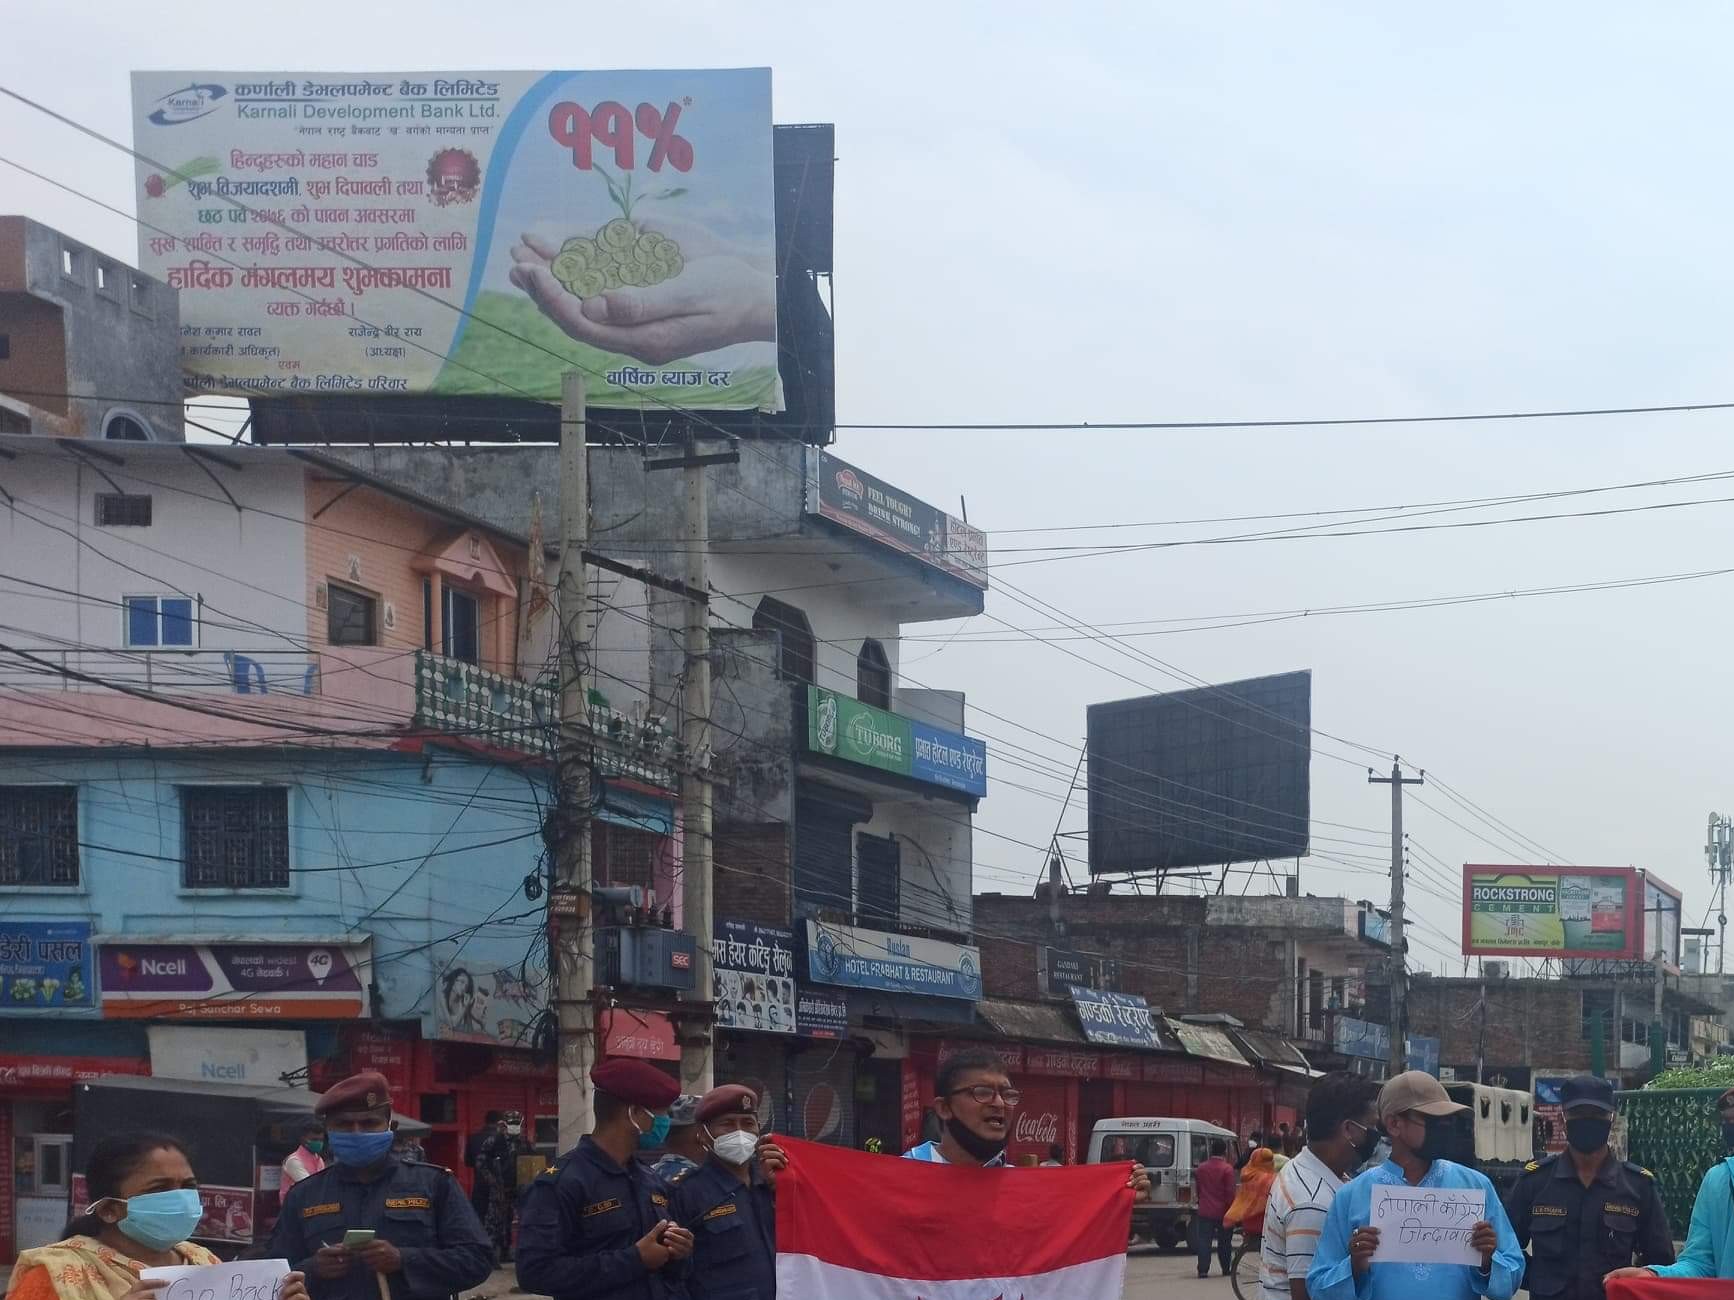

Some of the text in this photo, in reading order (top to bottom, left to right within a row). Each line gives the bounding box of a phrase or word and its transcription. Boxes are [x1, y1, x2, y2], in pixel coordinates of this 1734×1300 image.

[235, 80, 295, 97] कर्णाली
[434, 79, 500, 97] लिमिटेड
[237, 103, 501, 121] Karnali Development Bank Ltd.
[309, 152, 348, 169] महान
[352, 152, 378, 169] चाड
[306, 180, 331, 201] शुभ
[336, 177, 391, 197] दिपावली
[290, 206, 310, 224] को
[315, 208, 348, 224] पावन
[354, 208, 415, 225] अवसरमा
[433, 231, 467, 252] लागि
[167, 261, 234, 291] हार्दिक
[241, 261, 337, 289] मंगलमय
[606, 366, 732, 387] वार्षिक ब्याज दर
[868, 486, 885, 507] FEEL
[868, 503, 892, 526] DRINK
[855, 725, 903, 755] TUBORG
[932, 736, 949, 768] होटल
[1473, 887, 1555, 902] ROCKSTRONG
[1472, 903, 1554, 913] CEMENT
[37, 939, 84, 963] पसल
[310, 954, 329, 966] 4G
[728, 933, 748, 967] हेयर
[141, 958, 187, 976] Ncell
[240, 967, 255, 978] 4G
[845, 959, 870, 977] HOTEL
[870, 961, 903, 979] PRABHAT
[911, 967, 955, 985] RESTAURANT
[198, 1003, 246, 1015] Sanchar
[249, 1003, 282, 1015] Sewa
[201, 1061, 246, 1080] Ncell
[1377, 1189, 1440, 1218] नेपाली
